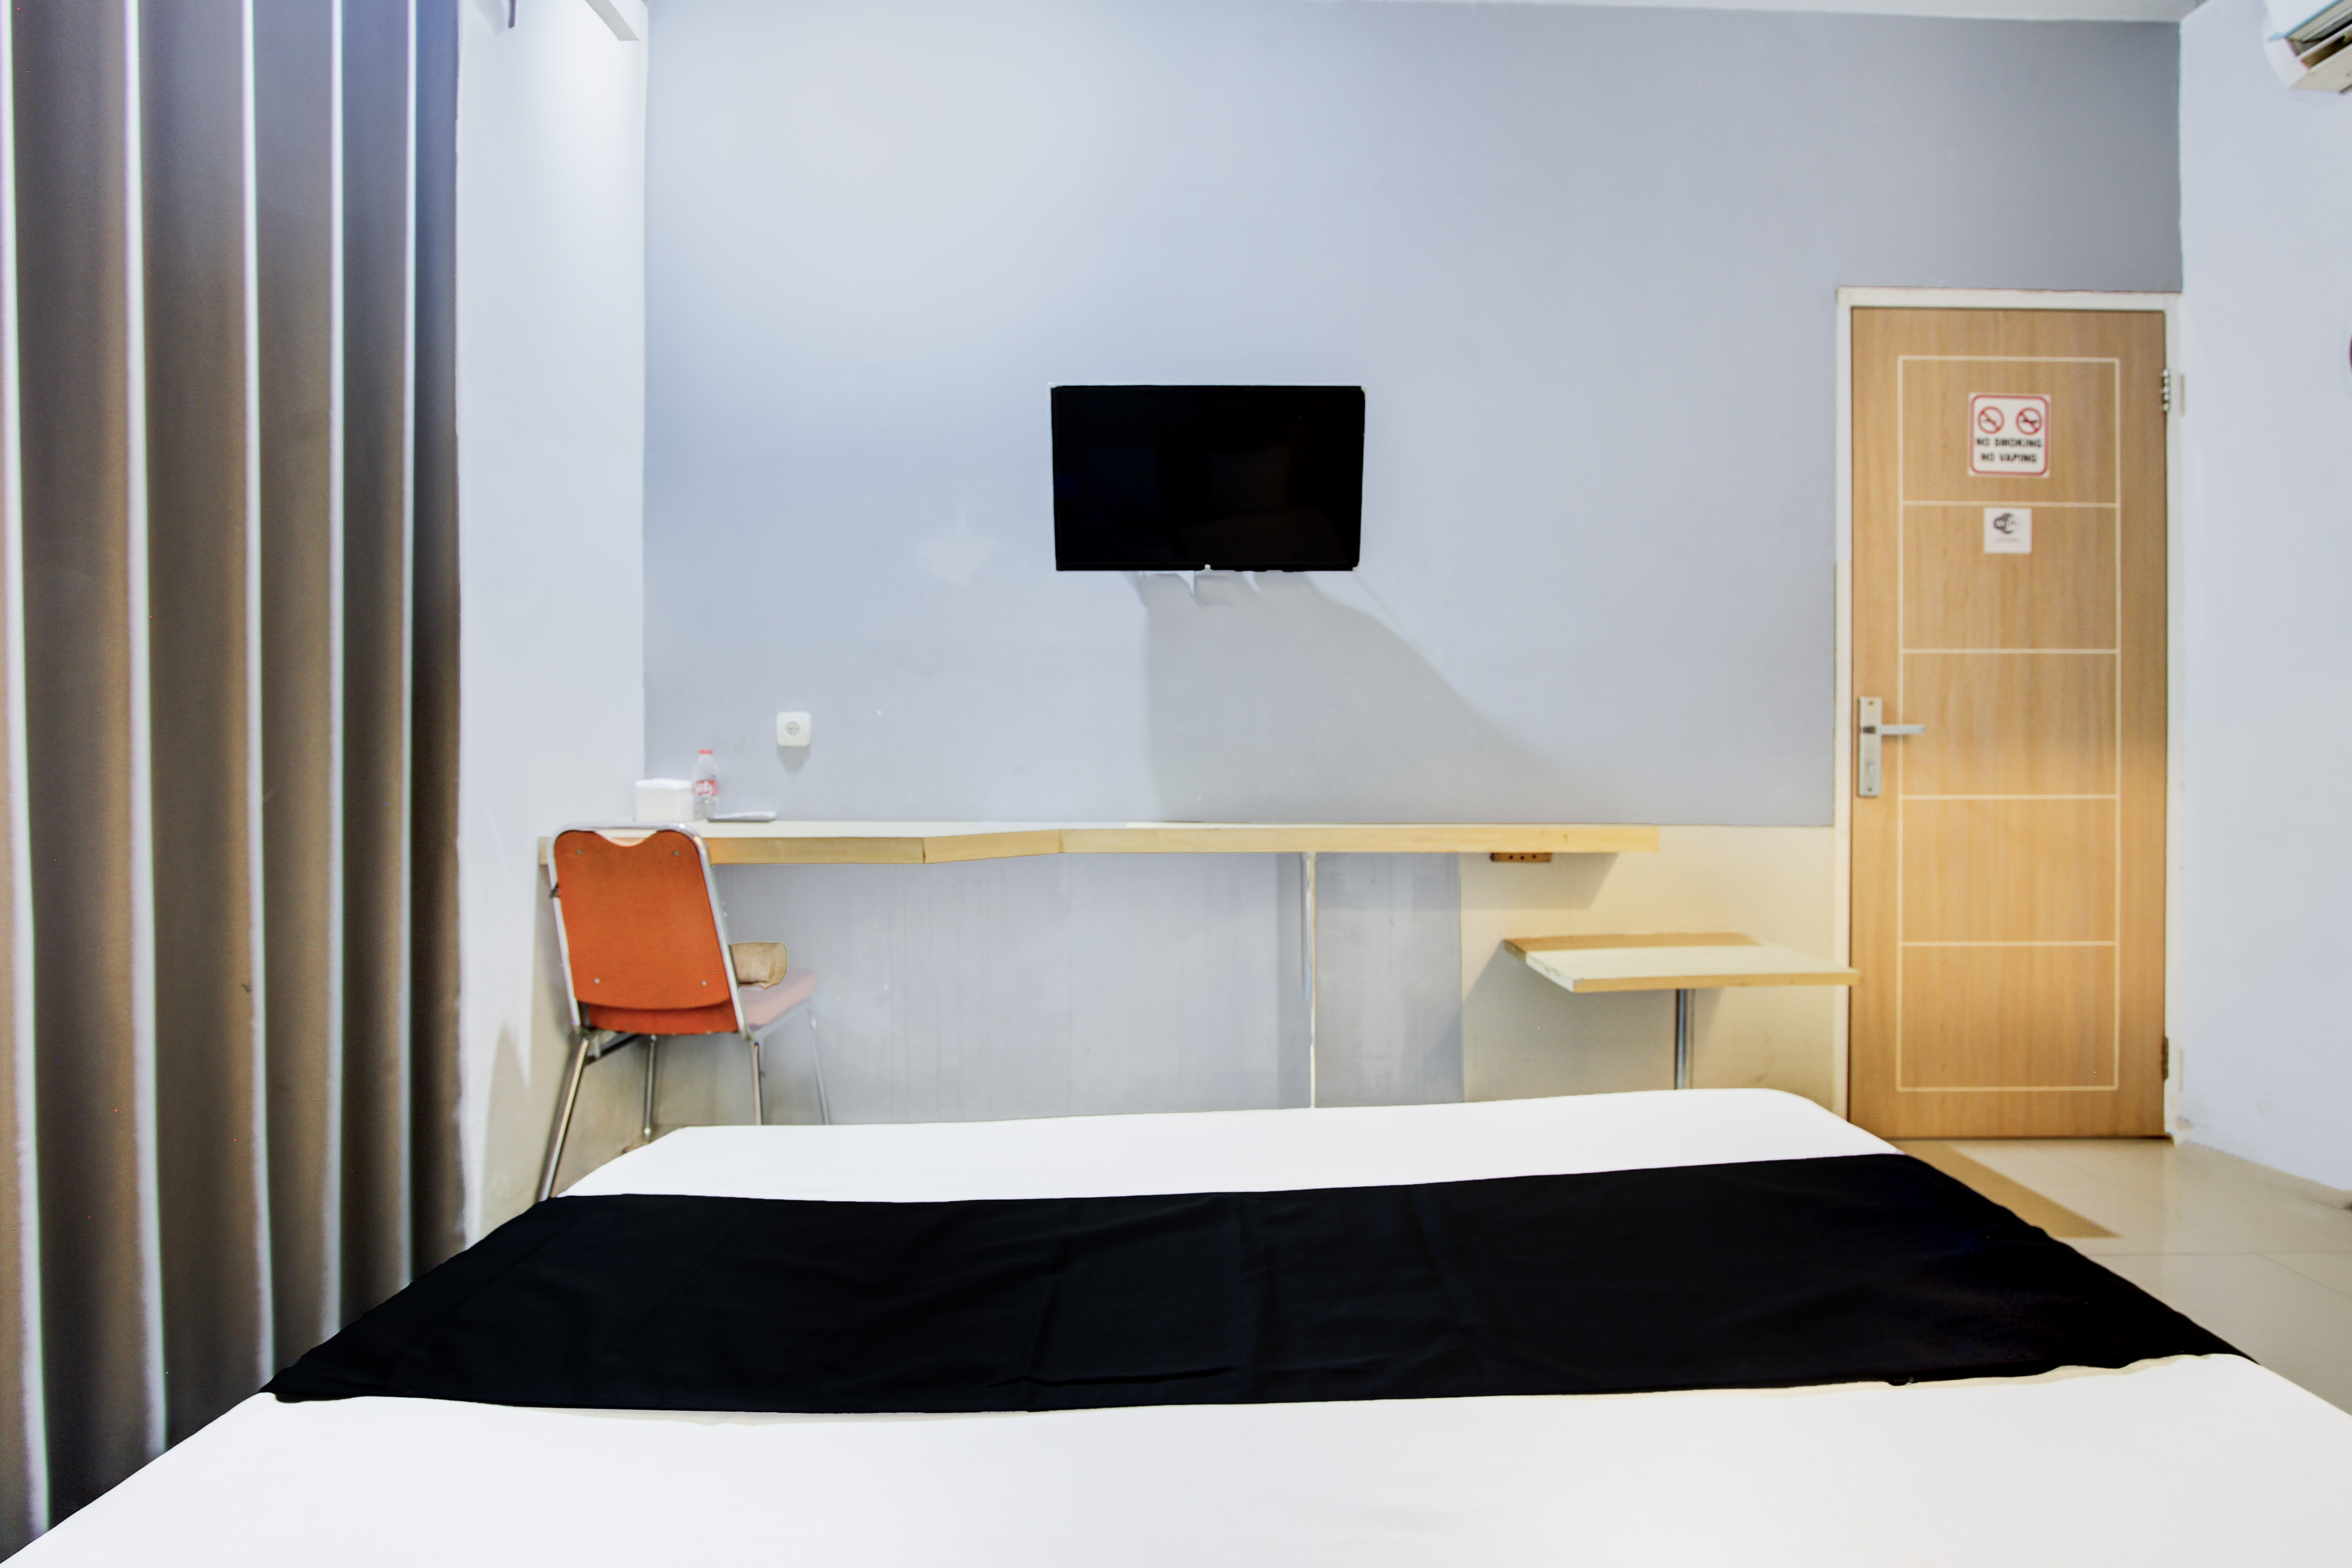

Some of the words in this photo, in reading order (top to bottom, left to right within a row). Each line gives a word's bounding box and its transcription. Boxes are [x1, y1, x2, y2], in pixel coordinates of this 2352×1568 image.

[1976, 438, 1990, 446] NO
[1995, 438, 2042, 447] SMOKING
[1981, 452, 1995, 461] NO
[1999, 453, 2038, 462] VAPING
